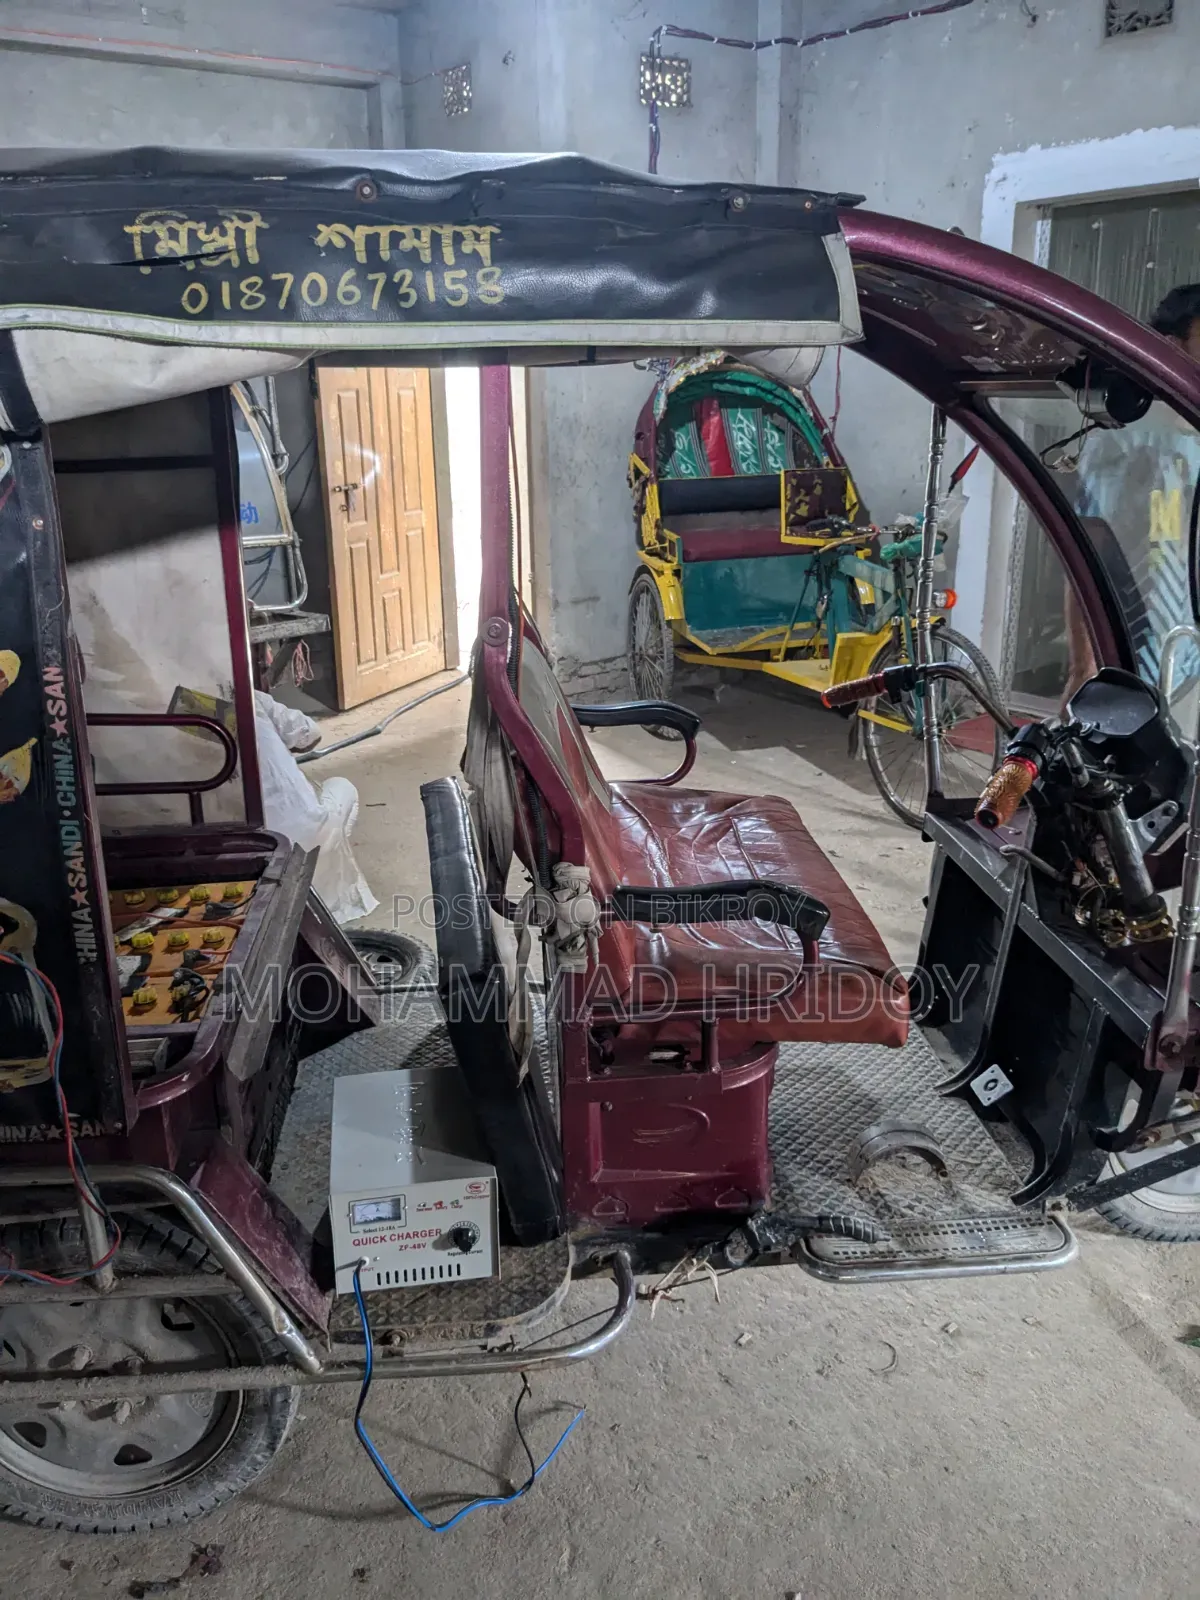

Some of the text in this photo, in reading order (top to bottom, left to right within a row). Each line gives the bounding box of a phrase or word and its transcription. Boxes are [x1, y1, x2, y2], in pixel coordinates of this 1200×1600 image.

[181, 267, 505, 315] 01870673158
[42, 665, 68, 717] SAN
[52, 738, 76, 807] CHINA
[59, 820, 87, 888] SANDI
[352, 1235, 388, 1247] QUICK
[389, 1228, 442, 1241] CHARGER
[363, 1227, 378, 1235] Select
